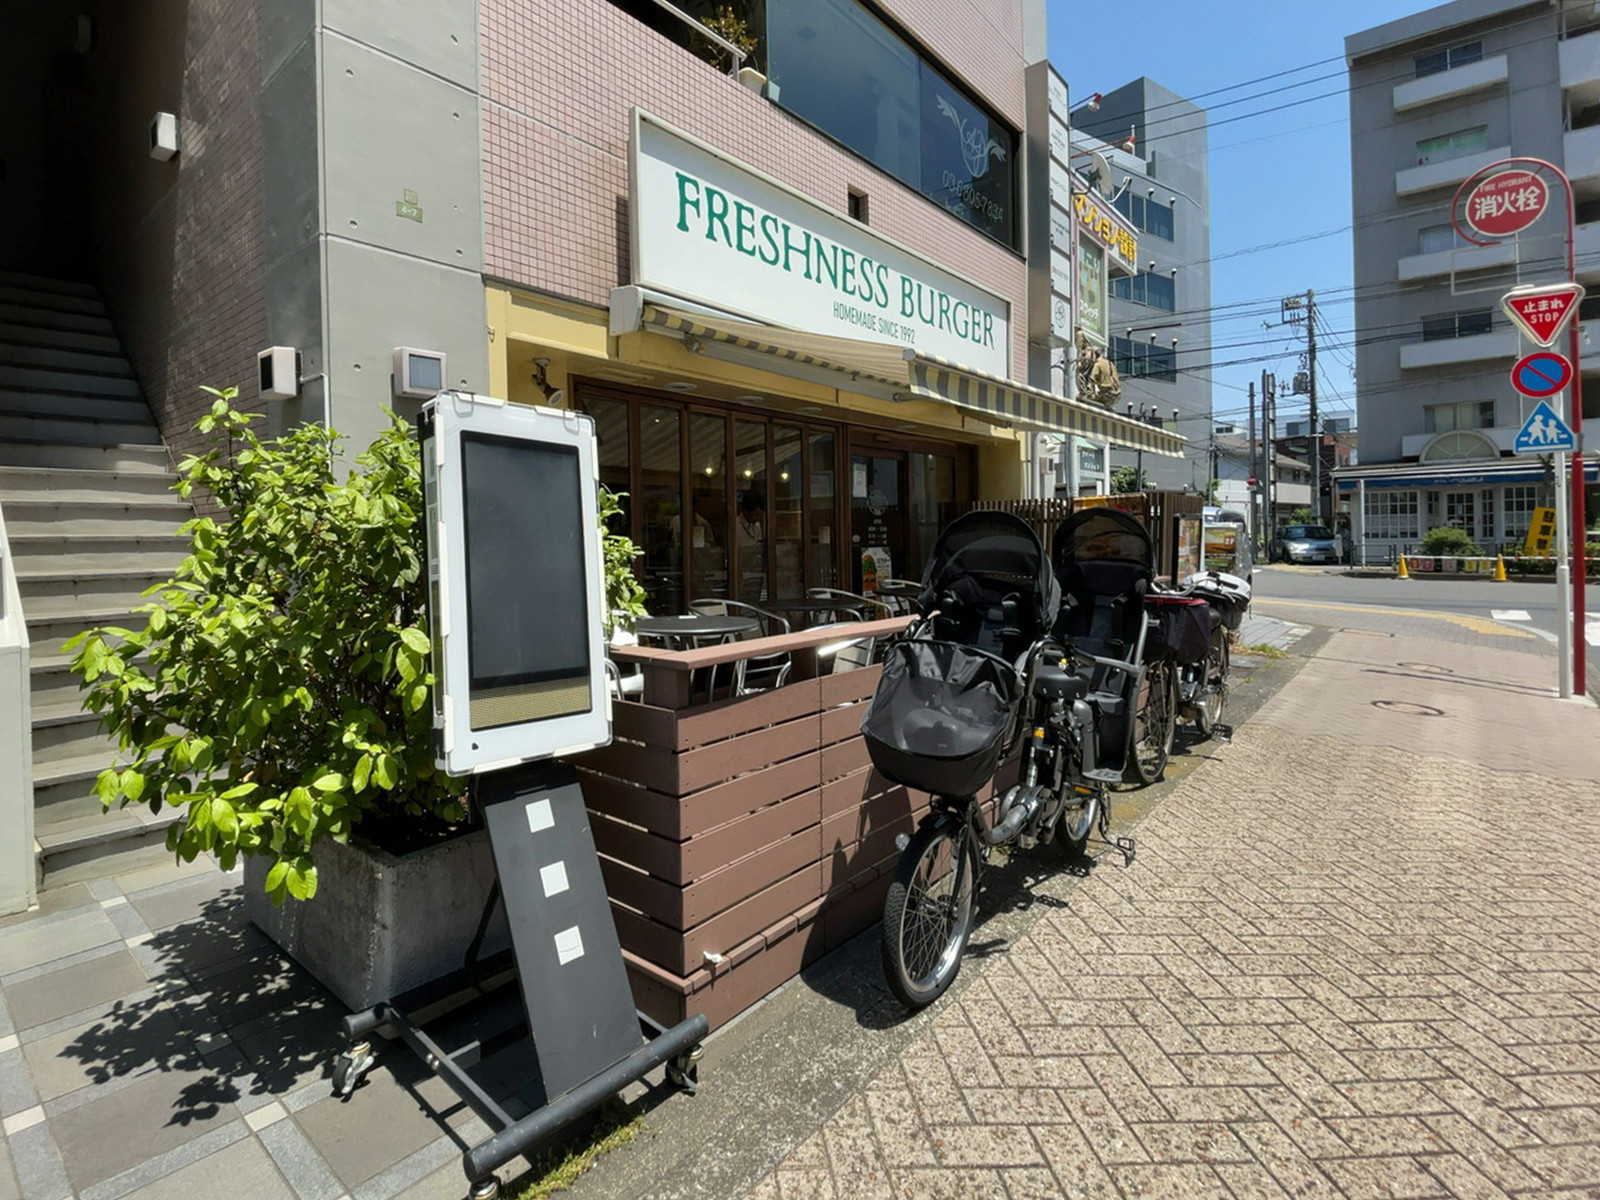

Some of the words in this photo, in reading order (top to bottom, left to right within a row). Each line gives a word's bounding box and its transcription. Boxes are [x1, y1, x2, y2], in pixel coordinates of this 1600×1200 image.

[1480, 183, 1496, 193] FIRE
[1498, 176, 1532, 189] HYDRANT
[1474, 185, 1541, 221] 消火栓
[675, 171, 889, 309] FRESHNESS
[900, 283, 995, 351] BURGER
[1522, 298, 1564, 314] 止まれ
[1530, 312, 1559, 324] STOP
[833, 301, 877, 331] HOMEMADE
[878, 317, 899, 339] SINCE
[900, 325, 916, 344] 1992
